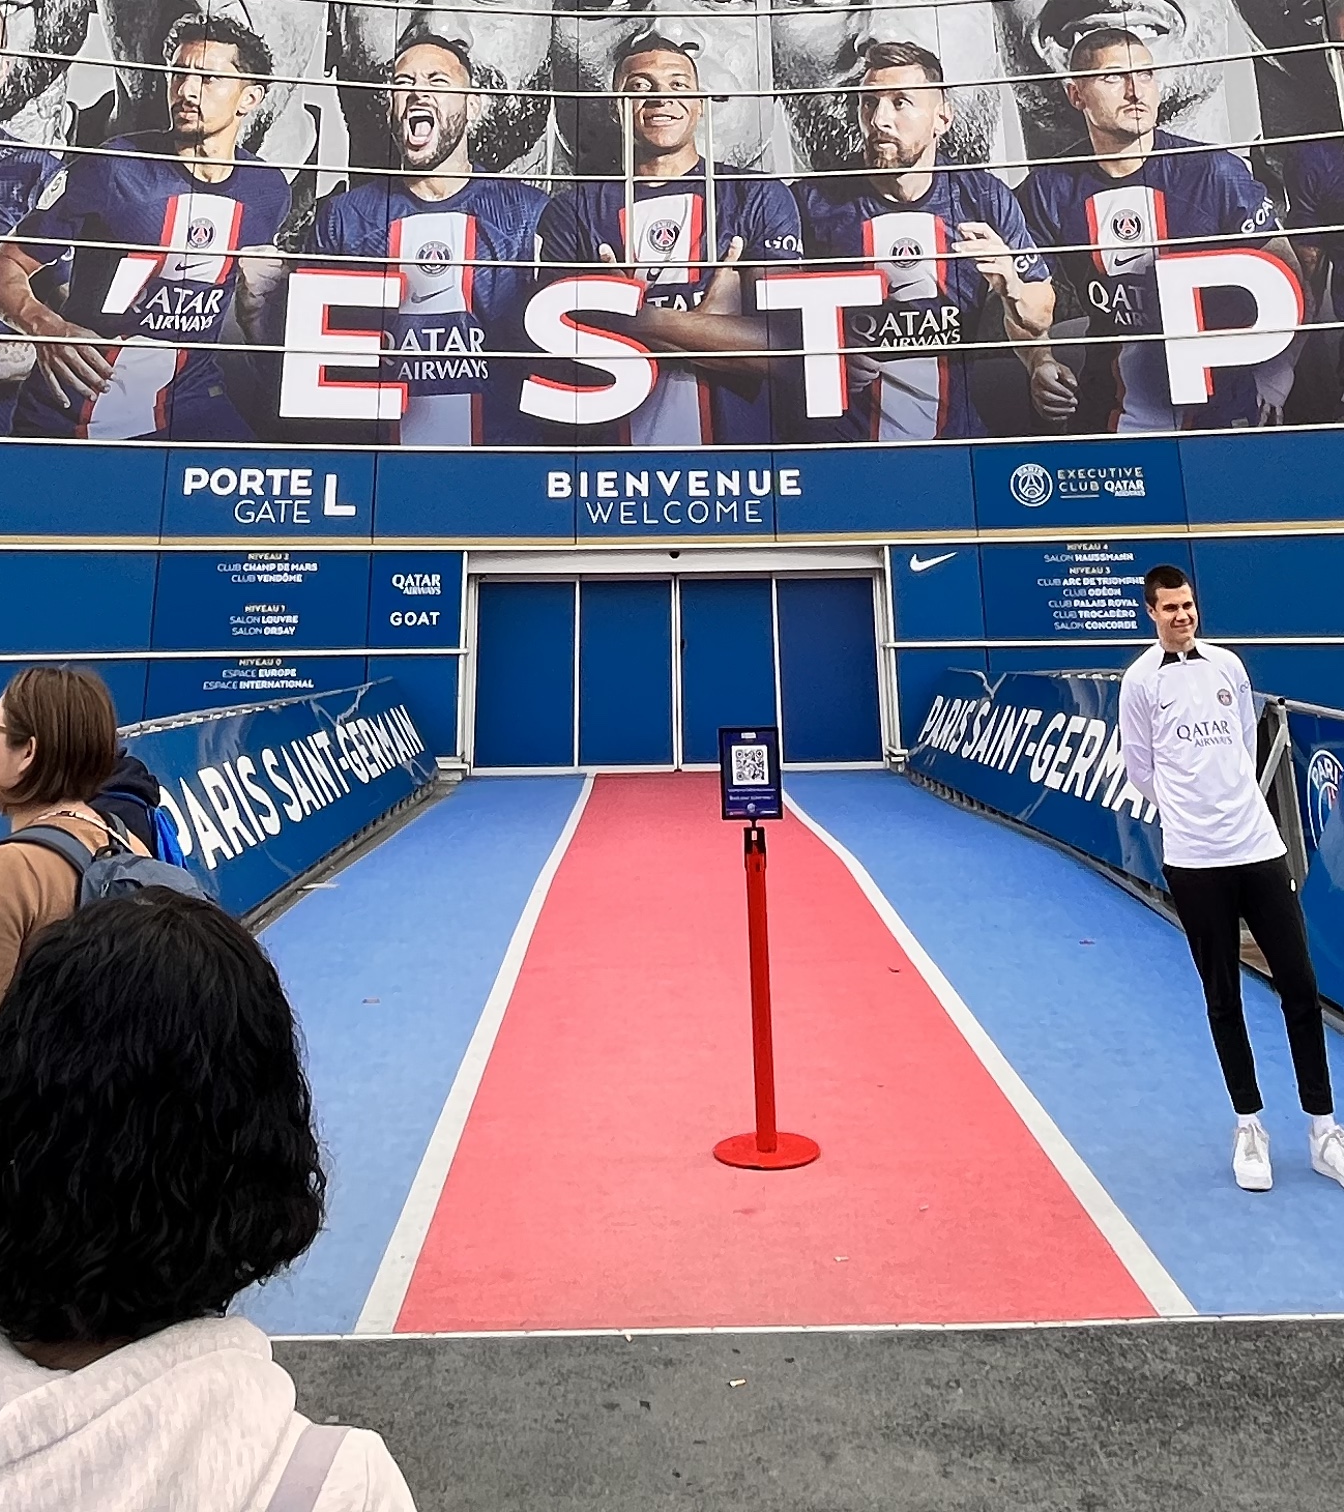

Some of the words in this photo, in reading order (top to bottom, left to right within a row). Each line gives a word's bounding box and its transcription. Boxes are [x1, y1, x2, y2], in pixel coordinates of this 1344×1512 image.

[1088, 280, 1146, 313] QAT
[140, 312, 215, 332] AIRWAYS
[851, 306, 960, 341] QATAR
[881, 328, 961, 347] AIRWAYS
[397, 358, 490, 382] AIRWAYS
[1057, 467, 1144, 480] EXECUTIVE
[547, 469, 803, 499] BIENVENUE
[1058, 481, 1100, 493] CLUB
[1104, 479, 1145, 494] QATAR
[183, 467, 313, 497] PORTE
[324, 474, 357, 517] L
[233, 499, 311, 524] GATE
[586, 500, 763, 524] WELCOME
[217, 563, 241, 572] CLUB
[242, 563, 276, 572] CHAMP
[277, 563, 290, 571] DE
[291, 562, 318, 571] MARS
[231, 574, 256, 583] CLUB
[392, 574, 441, 589] QATAR
[1037, 578, 1061, 587] CLUB
[1062, 578, 1081, 586] ARC
[1063, 589, 1087, 597] CLUB
[1048, 599, 1072, 608] CLUB
[229, 616, 260, 625] SALON
[261, 615, 299, 624] LOUVRE
[389, 611, 440, 626] GOAT
[1053, 610, 1077, 619] CLUB
[232, 627, 262, 636] SALON
[1054, 621, 1084, 630] SALON
[258, 669, 297, 678] EUROPE
[239, 679, 314, 690] INTERNATIONAL
[1176, 720, 1230, 742] QATAR
[262, 704, 425, 823] SAINT-GERMAIN
[918, 695, 978, 755] PARIS
[960, 701, 1158, 825] SAINT-GERMA
[1311, 757, 1342, 794] PARI
